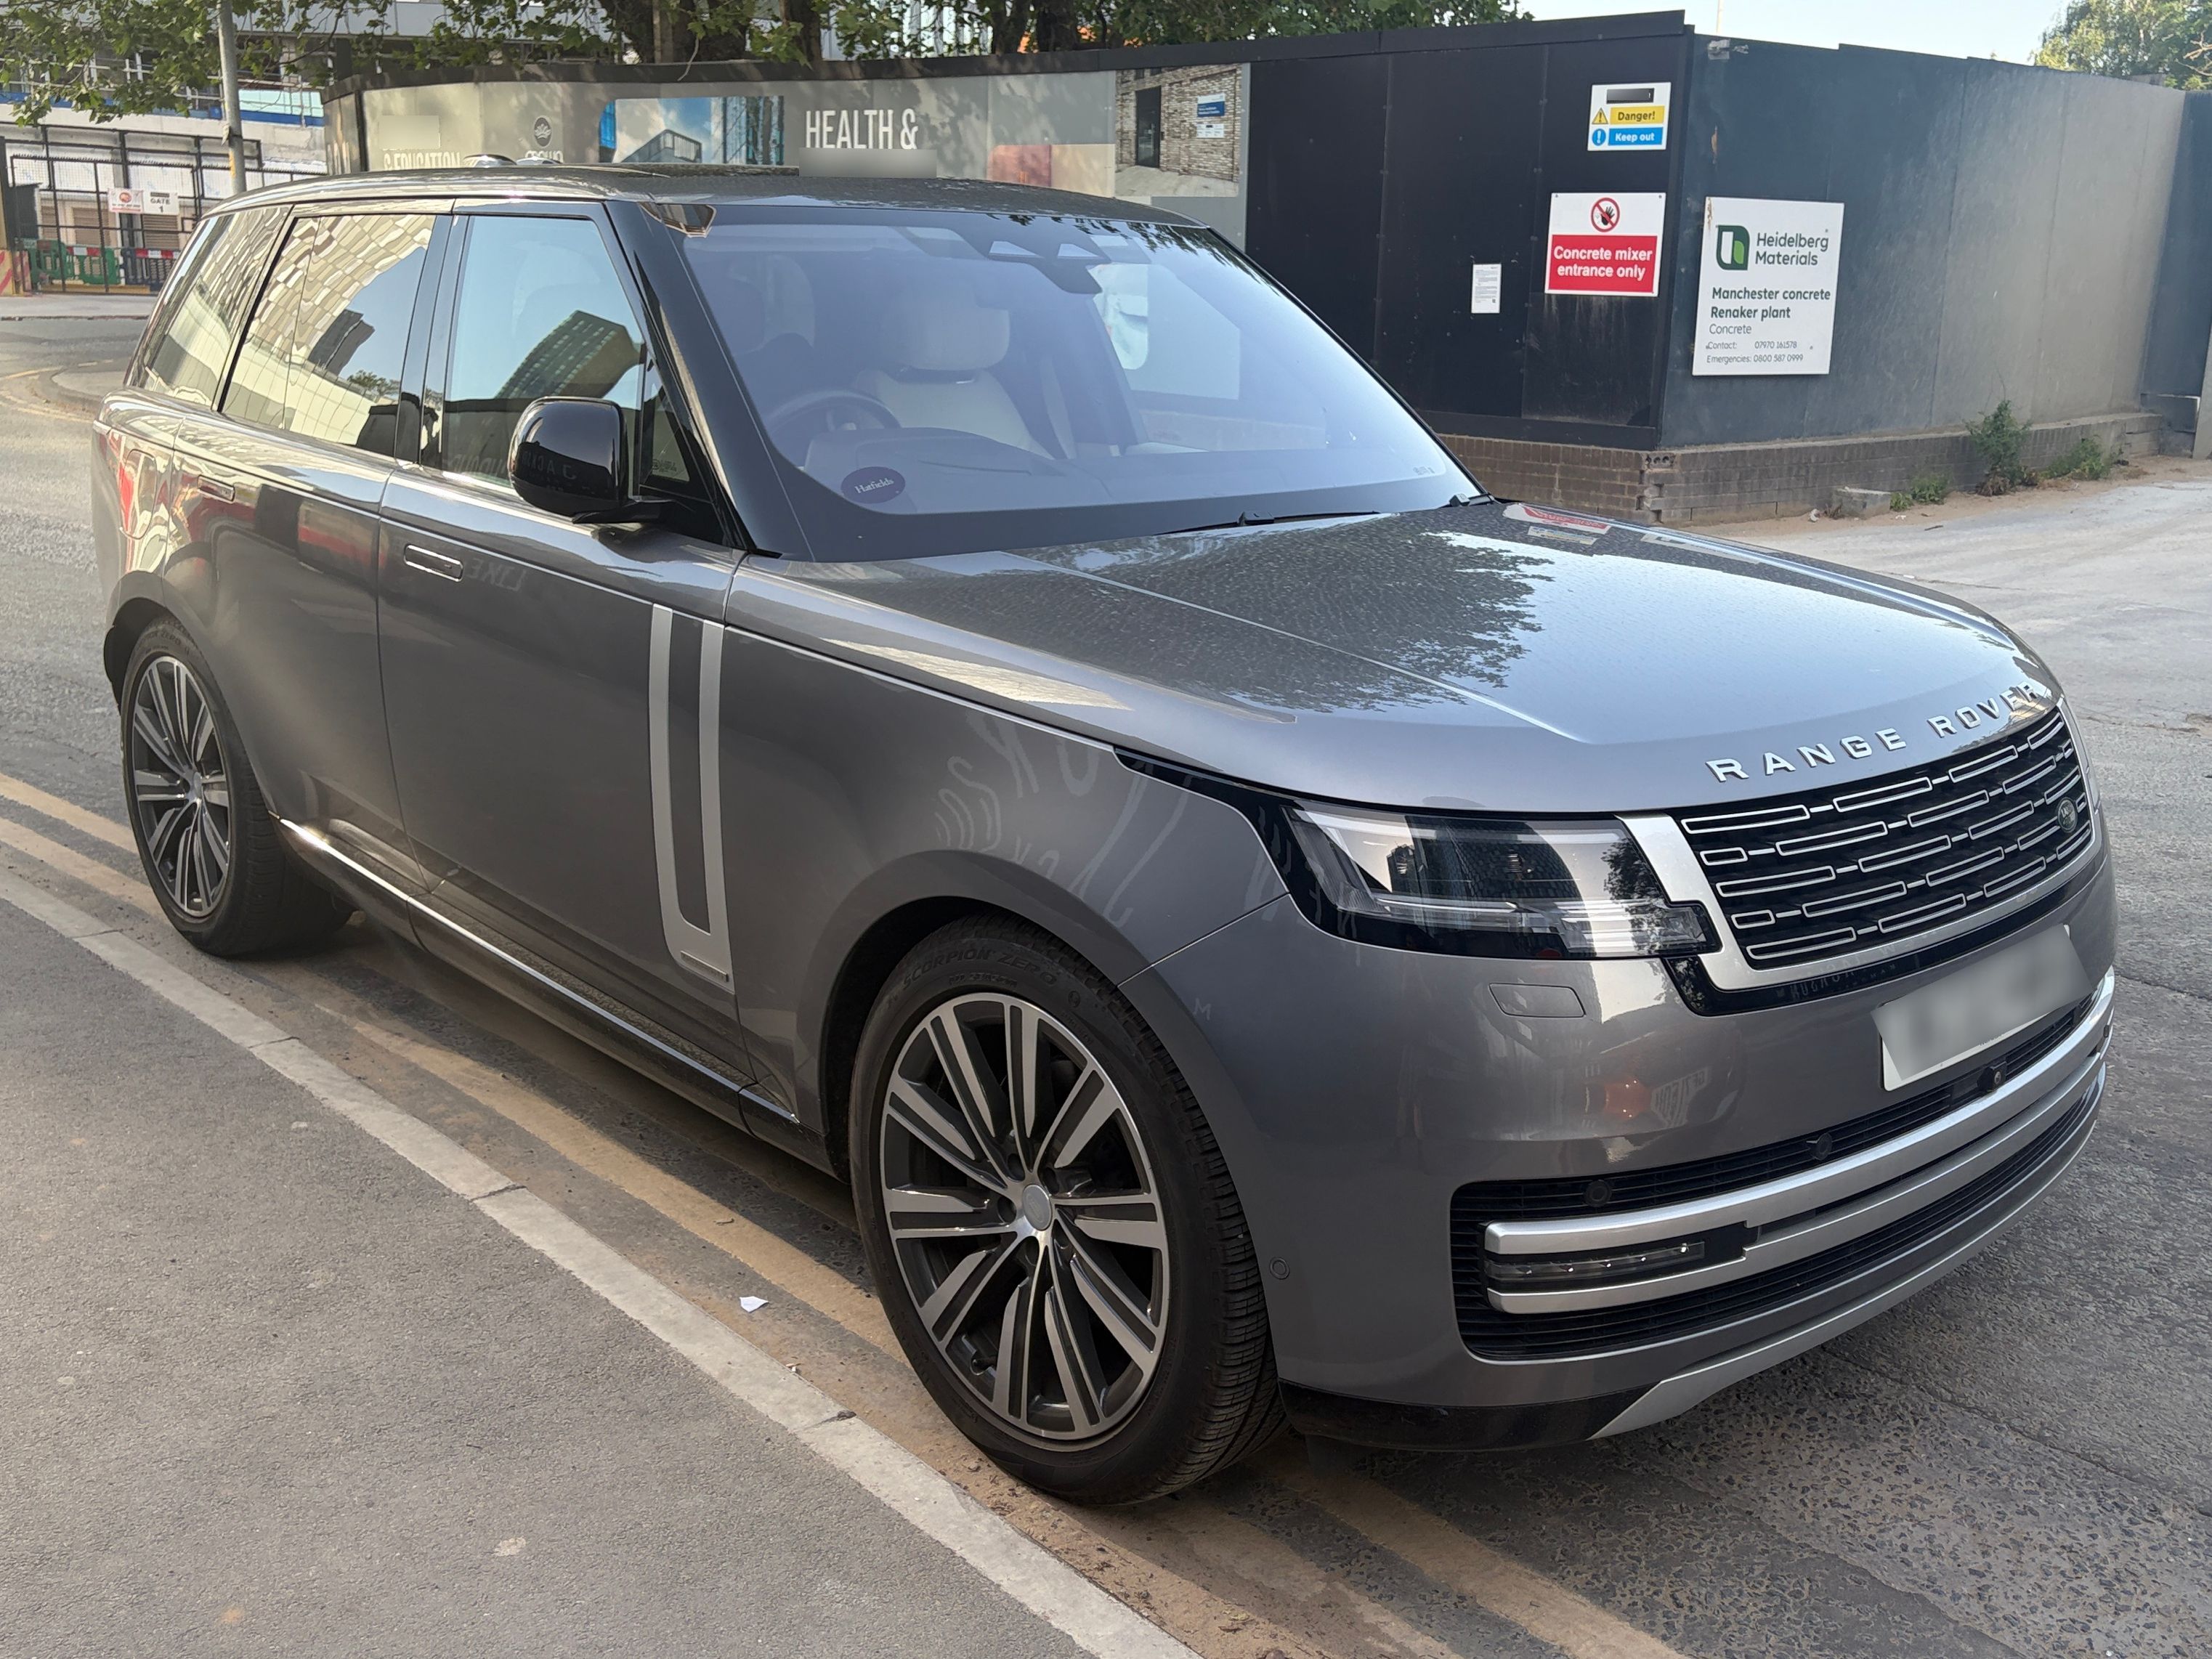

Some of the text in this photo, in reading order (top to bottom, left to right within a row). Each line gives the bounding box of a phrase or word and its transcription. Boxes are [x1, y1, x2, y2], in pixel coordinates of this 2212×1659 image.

[1618, 111, 1656, 122] Danger!
[806, 108, 918, 150] HEALTH &
[1615, 132, 1655, 142] Keep out
[1757, 232, 1829, 252] Heidelberg
[1553, 246, 1653, 261] Concrete mixer
[1755, 250, 1818, 265] Materials
[1557, 264, 1645, 281] entrance only
[1711, 287, 1831, 300] Manchester concrete
[1711, 306, 1791, 321] Renaker plant
[1709, 323, 1751, 334] Concrete
[1706, 354, 1751, 365] Emergencies:
[854, 477, 894, 494] Hatfields
[1706, 681, 2038, 782] RANGE ROVER
[903, 946, 1058, 990] SCORPION ZERO
